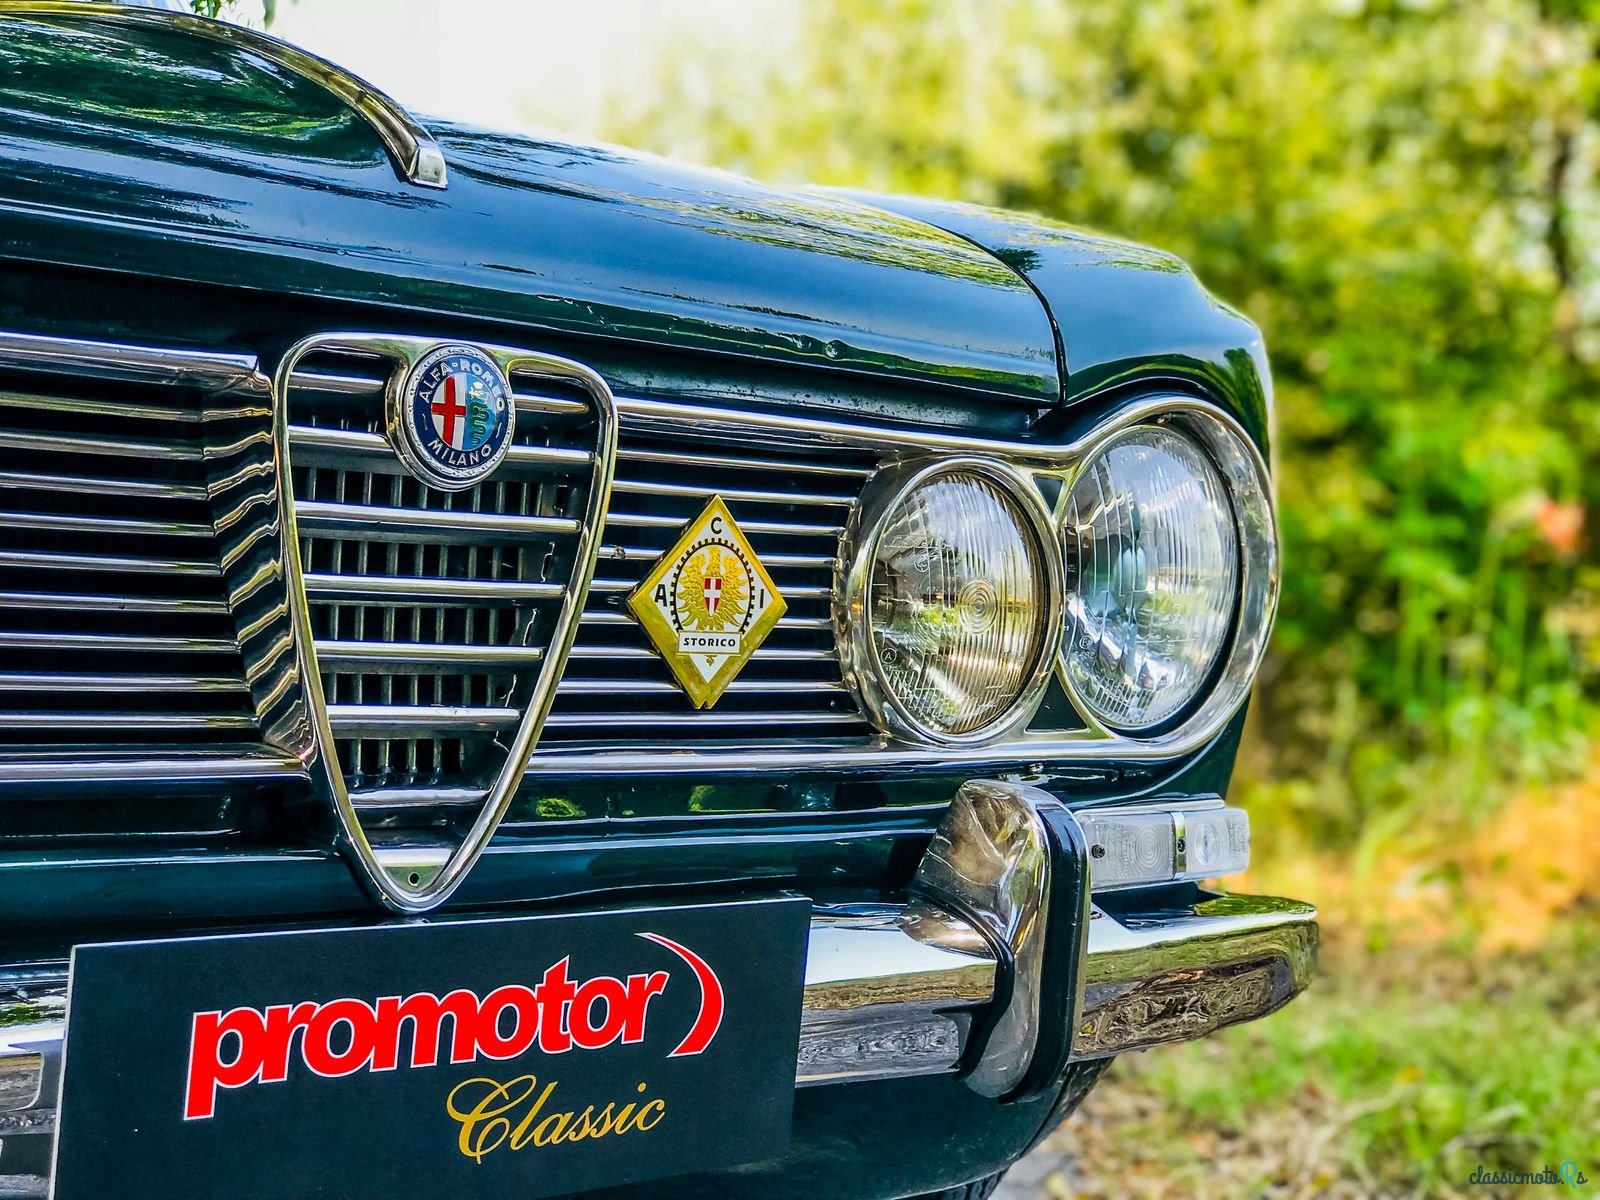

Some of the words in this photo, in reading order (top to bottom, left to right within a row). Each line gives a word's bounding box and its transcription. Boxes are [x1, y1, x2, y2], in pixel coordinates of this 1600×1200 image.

[427, 437, 492, 466] MILANO
[710, 516, 723, 535] C
[654, 583, 668, 607] A
[683, 637, 736, 647] STORICO
[183, 954, 670, 1121] promotor
[446, 1074, 665, 1165] Classic
